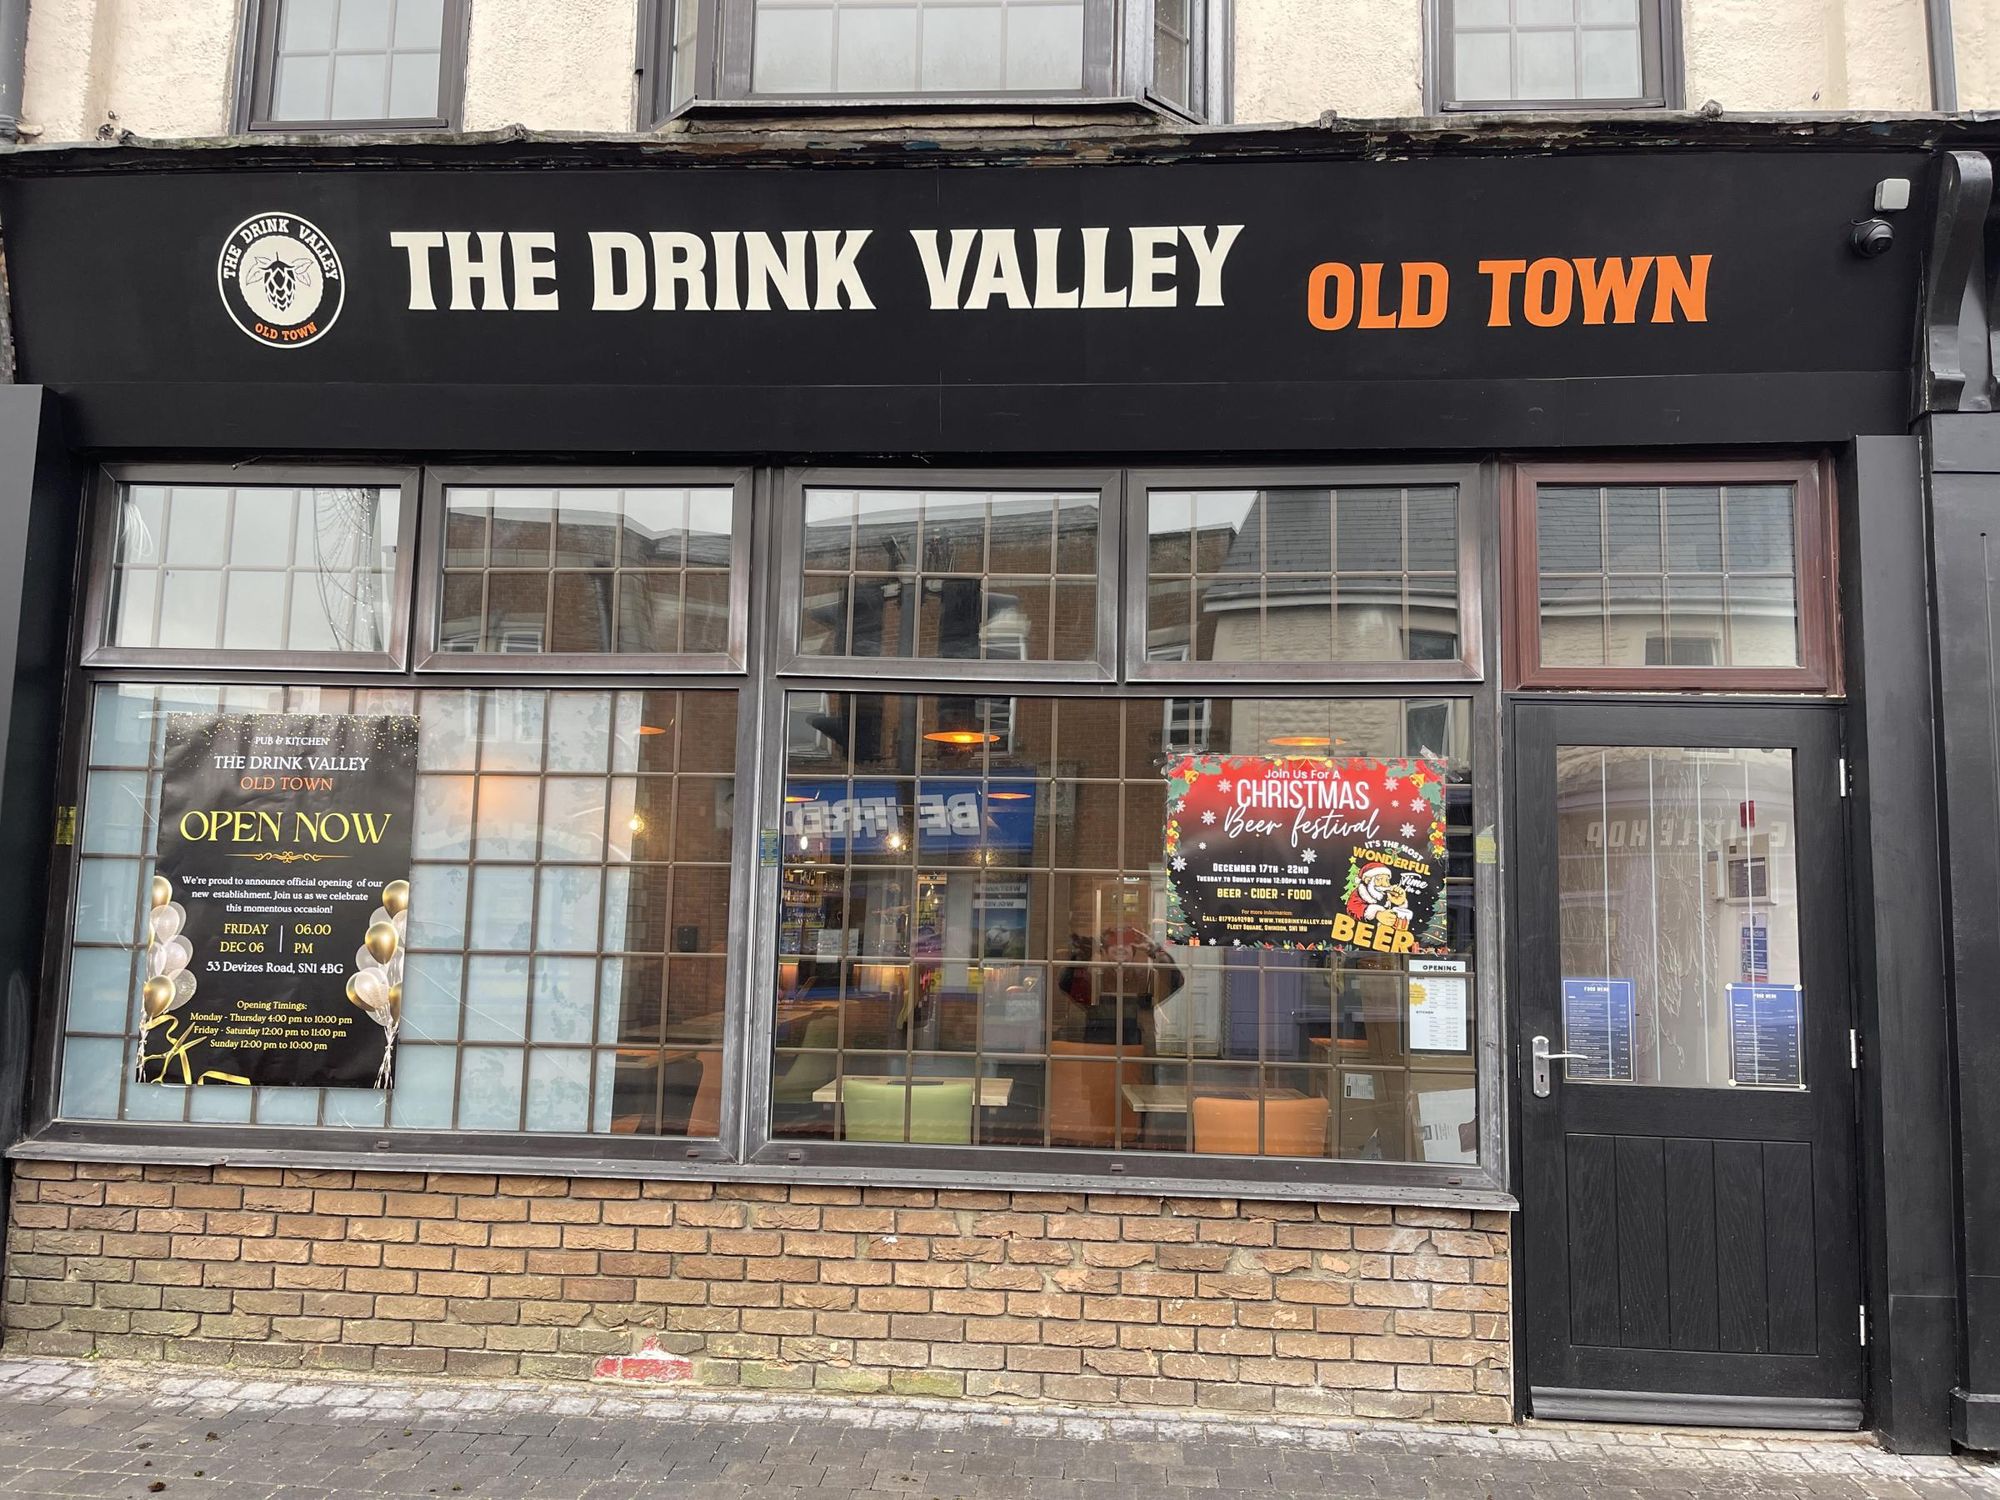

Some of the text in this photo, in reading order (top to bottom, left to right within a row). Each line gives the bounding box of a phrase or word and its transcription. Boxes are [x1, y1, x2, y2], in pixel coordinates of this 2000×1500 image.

[224, 218, 339, 280] THE DRINK VALLEY
[390, 224, 1245, 311] THE DRINK VALLEY
[1307, 254, 1713, 330] OLD TOWN
[255, 321, 318, 341] OLD TOWN
[254, 736, 329, 746] PUB & KITCHEN
[214, 756, 369, 771] THE DRINK VALLEY
[1265, 769, 1341, 780] Join Us For A
[240, 776, 333, 791] OLD TOWN
[1236, 779, 1370, 810] CHRISTMAS
[180, 811, 393, 844] OPEN NOW
[1224, 805, 1380, 848] Beer festival
[1364, 840, 1424, 861] IT'S THE MOST
[1352, 846, 1431, 876] WONDERFUL
[1213, 863, 1256, 872] DECEMBER
[1259, 864, 1278, 874] 17TH
[1287, 865, 1309, 874] 22ND
[182, 876, 206, 884] We're
[208, 877, 233, 886] proud
[235, 877, 243, 885] to
[245, 878, 285, 886] announce
[287, 877, 316, 886] official
[318, 879, 353, 888] opening
[356, 879, 366, 887] of
[1400, 872, 1428, 889] Time
[213, 890, 272, 899] establishment.
[273, 891, 290, 900] Join
[329, 892, 368, 901] celebrate
[1217, 888, 1242, 898] BEER
[1250, 888, 1278, 899] CIDER
[1287, 889, 1312, 900] FOOD
[226, 904, 333, 914] this momentous occasion!
[224, 923, 332, 935] FRIDAY 06.00
[1331, 912, 1415, 954] BEER
[220, 942, 313, 954] DEC 06 PM
[206, 961, 344, 974] 53 Devizes Road, SN1 4BG
[237, 1000, 307, 1011] Opening Timings:
[190, 1012, 223, 1023] Monday
[230, 1013, 267, 1024] Thursday
[268, 1014, 287, 1022] 4:00
[314, 1015, 337, 1024] 10:00
[194, 1026, 219, 1036] Friday
[226, 1026, 260, 1037] Saturday
[262, 1027, 283, 1035] 12:00
[285, 1030, 298, 1038] pm
[311, 1028, 331, 1037] 11:00
[332, 1031, 347, 1039] pm
[210, 1039, 239, 1050] Sunday
[240, 1040, 262, 1048] 12:00
[263, 1042, 277, 1050] pm
[289, 1041, 313, 1049] 10:00
[314, 1043, 327, 1052] pm
